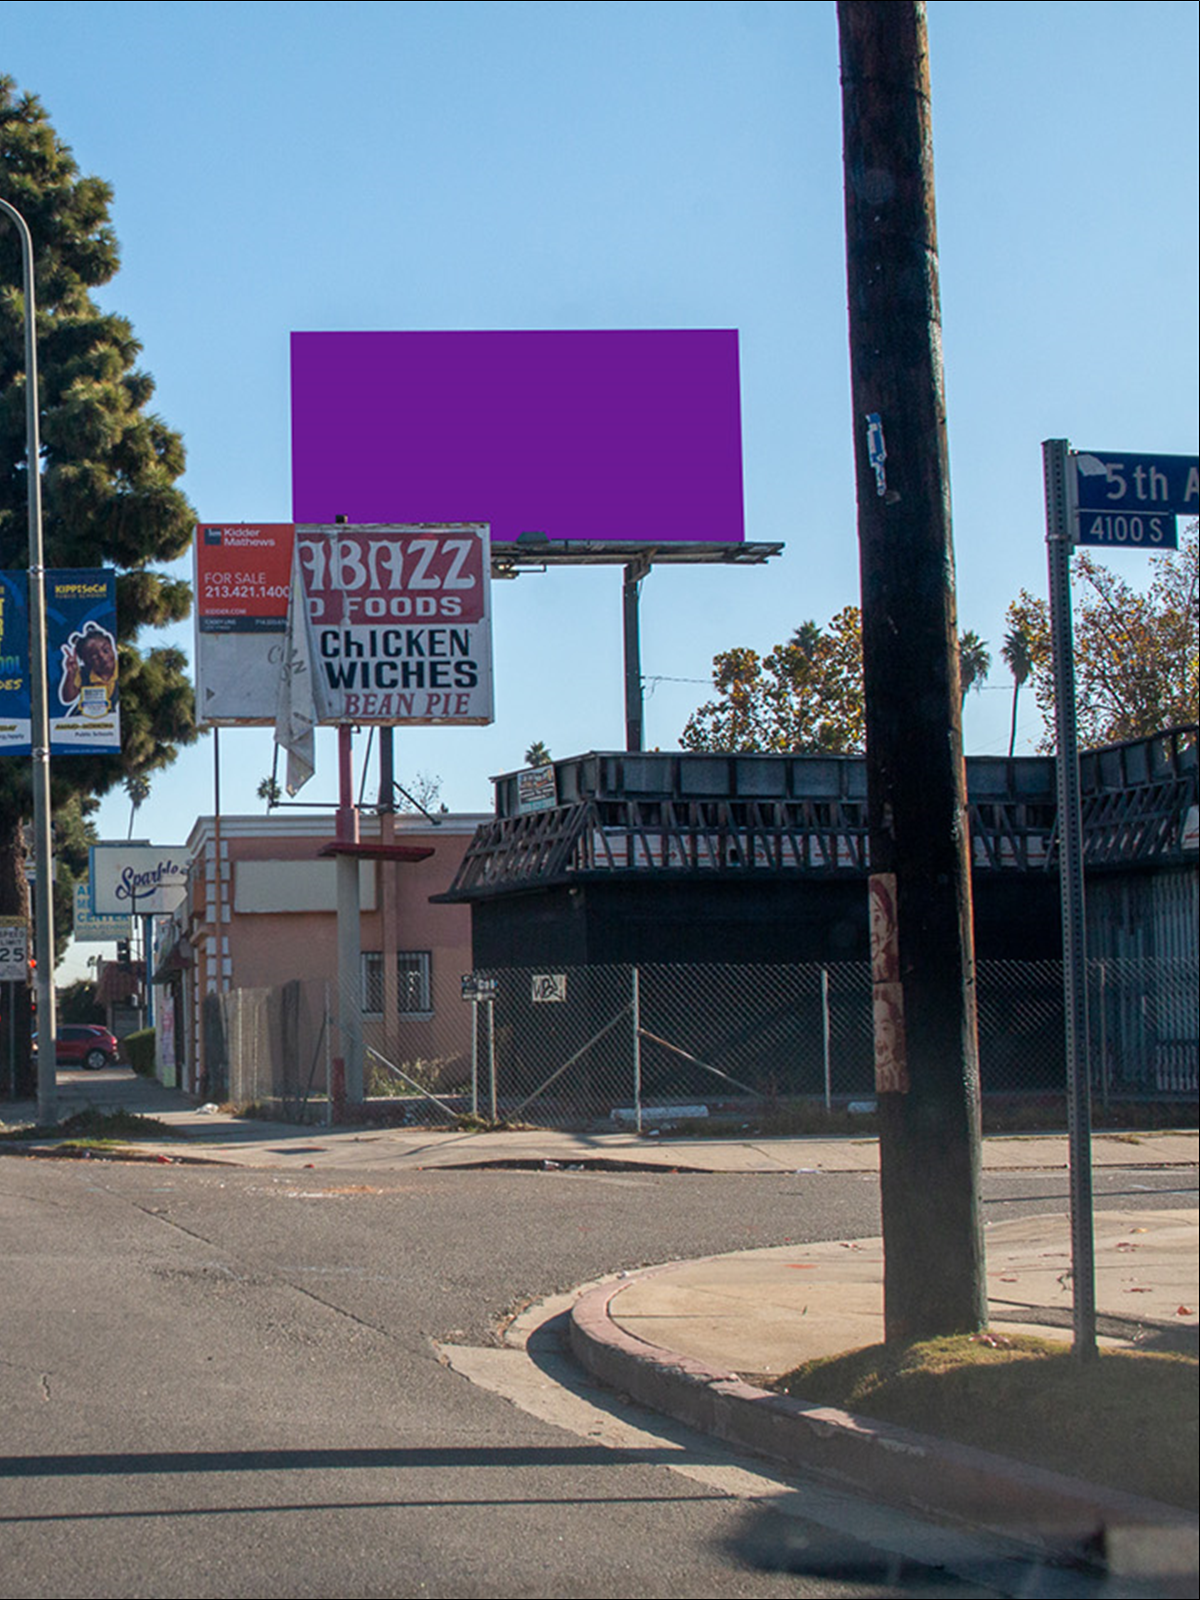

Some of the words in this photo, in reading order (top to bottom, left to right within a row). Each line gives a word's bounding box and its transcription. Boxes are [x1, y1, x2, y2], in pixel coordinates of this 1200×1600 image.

[1105, 463, 1168, 501] 5th
[224, 528, 260, 537] Kidder
[1090, 516, 1144, 542] 4100
[1150, 517, 1164, 543] S
[224, 538, 275, 546] Mathews
[204, 572, 232, 585] FOR
[235, 572, 266, 585] SALE
[205, 586, 289, 598] 213.421.1400
[347, 596, 462, 617] FOODS
[324, 661, 478, 689] WICHES
[344, 693, 415, 716] BEAN
[426, 693, 470, 715] PIE
[0, 947, 25, 963] 25
